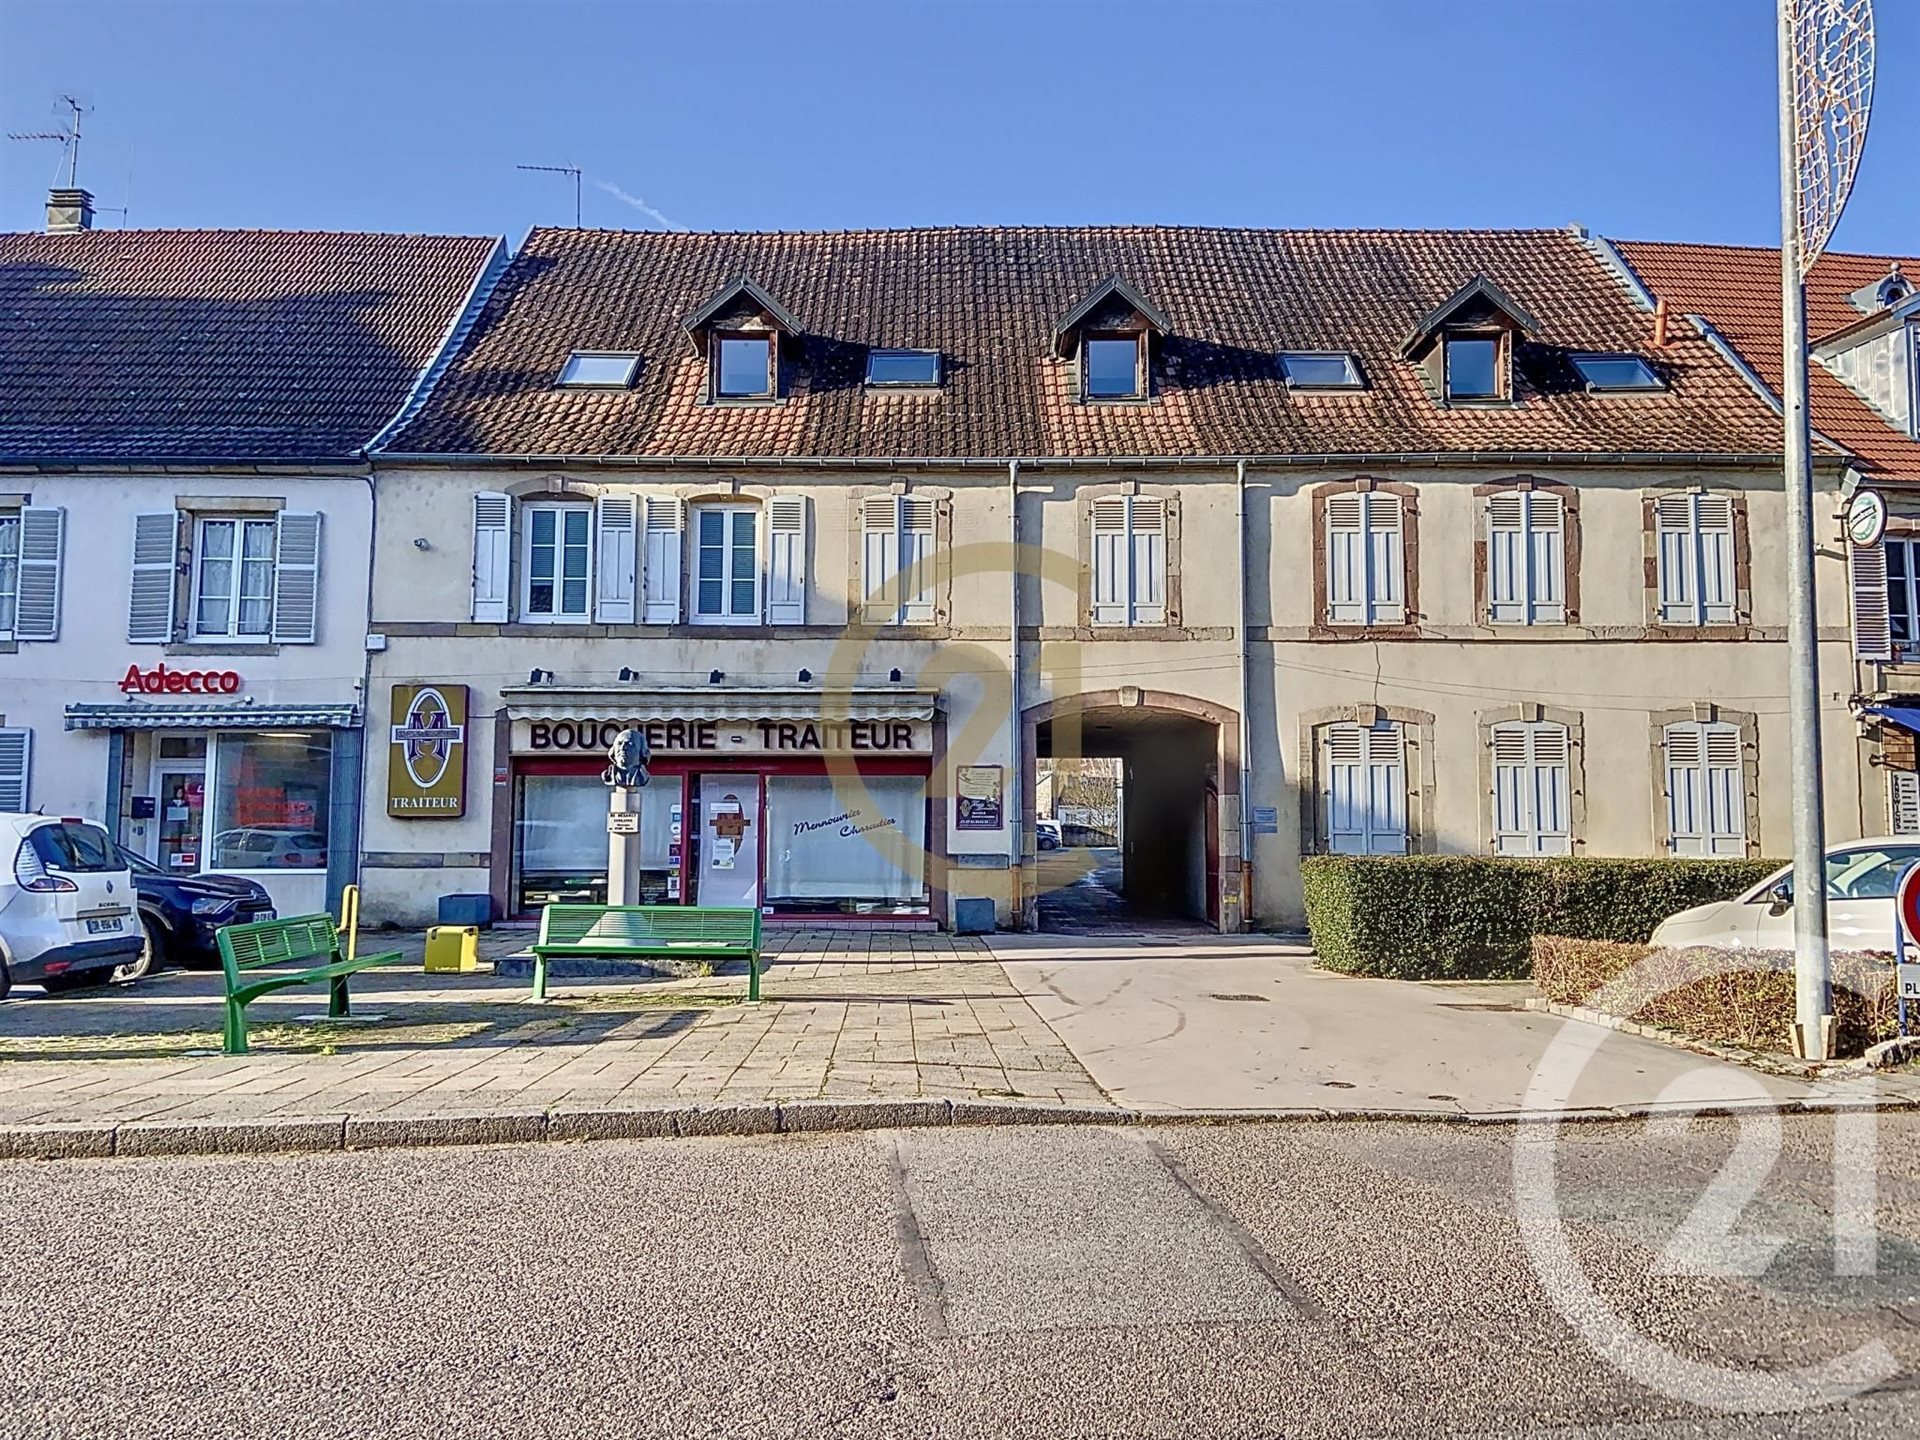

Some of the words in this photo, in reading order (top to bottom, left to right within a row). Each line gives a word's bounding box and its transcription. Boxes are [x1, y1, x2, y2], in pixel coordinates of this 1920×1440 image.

[118, 662, 239, 693] Adecco
[530, 722, 716, 749] BOUCERIE
[757, 722, 912, 749] TRAITEUR
[391, 796, 458, 809] TRAITEUR
[839, 816, 896, 838] Charcutier
